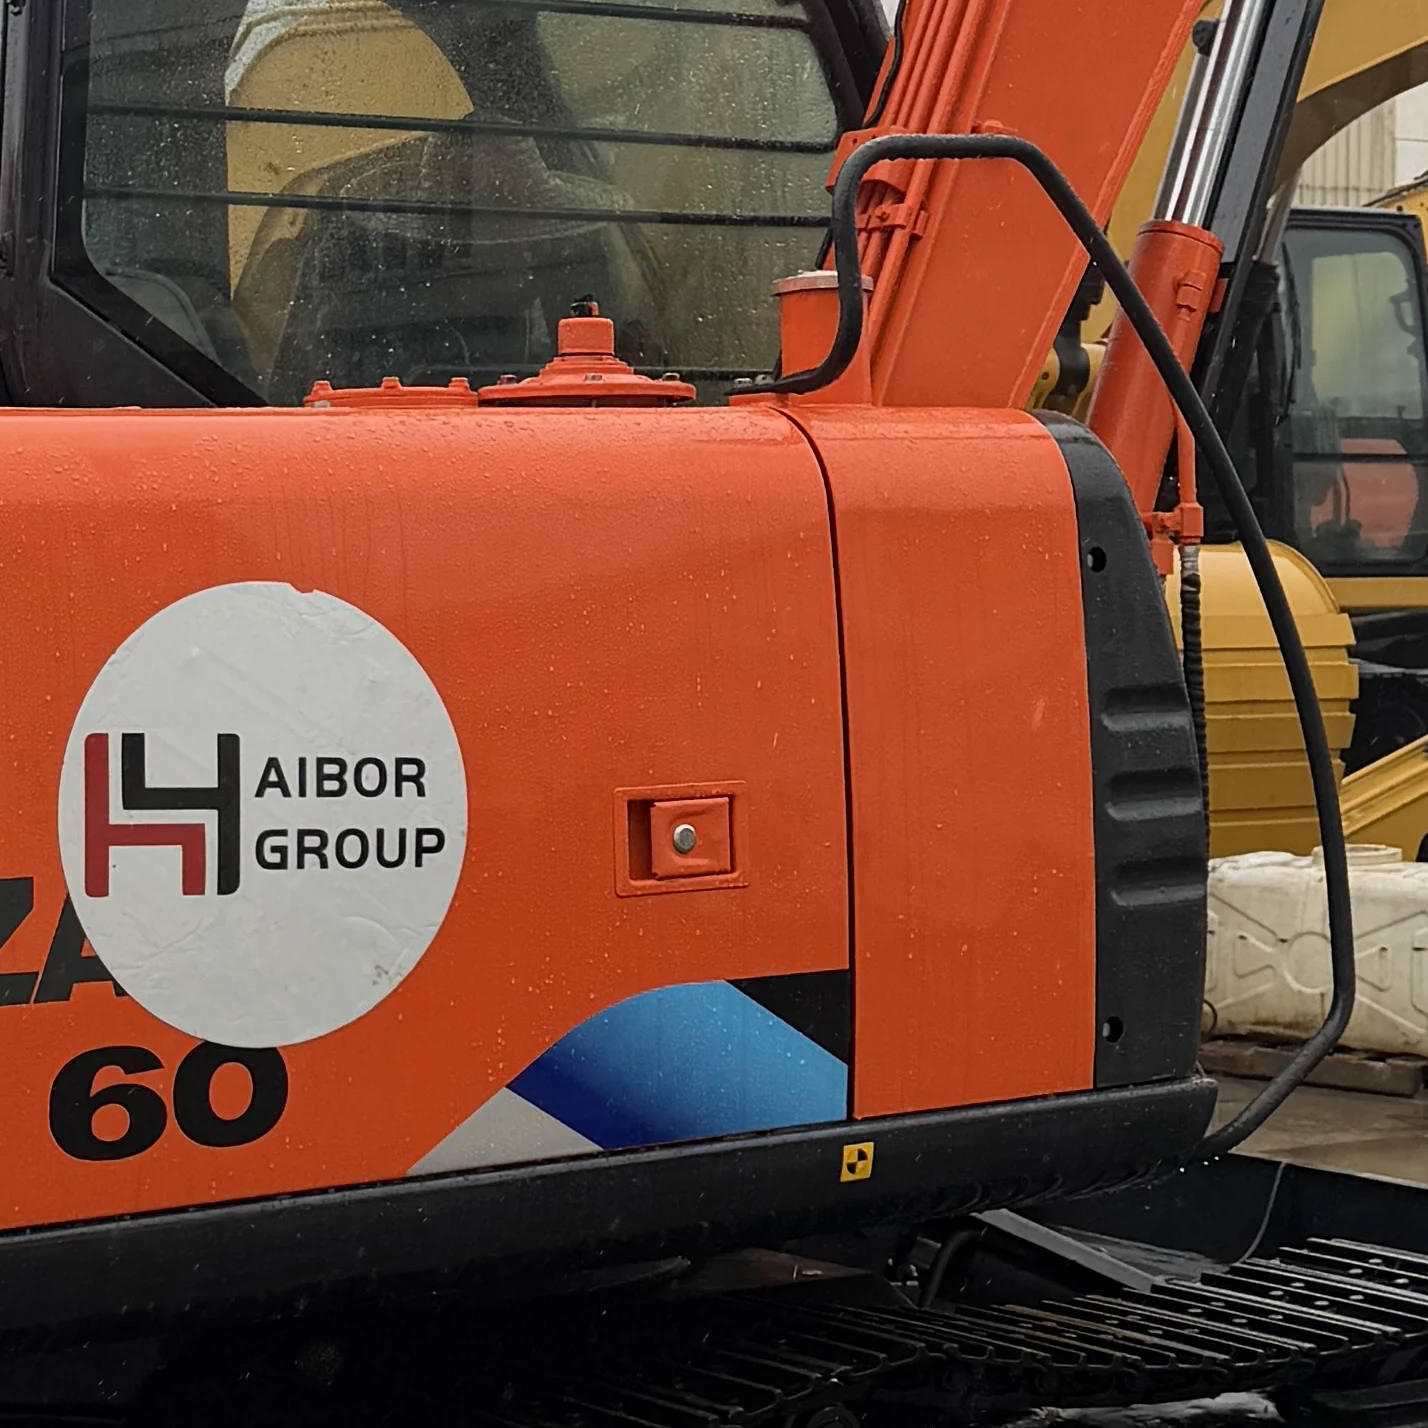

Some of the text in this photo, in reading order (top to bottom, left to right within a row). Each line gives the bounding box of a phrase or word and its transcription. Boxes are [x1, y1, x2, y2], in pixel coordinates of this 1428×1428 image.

[254, 756, 427, 798] AIBOR
[254, 827, 447, 871] GROUP
[48, 1039, 289, 1162] 60
